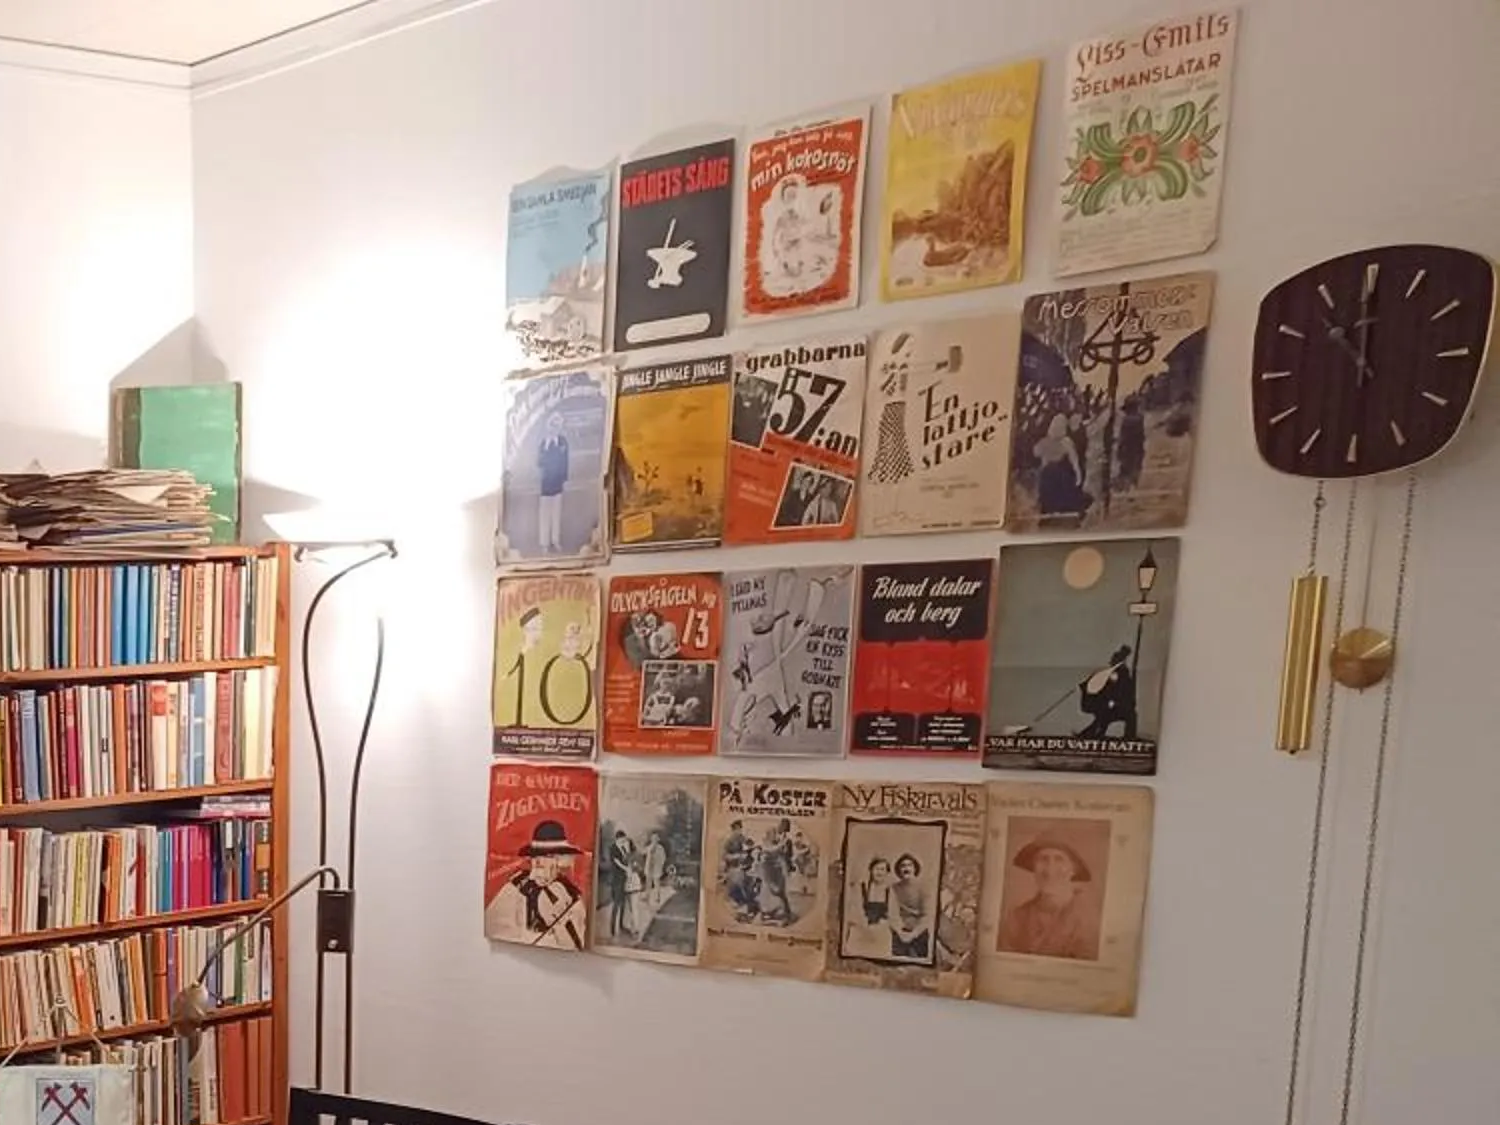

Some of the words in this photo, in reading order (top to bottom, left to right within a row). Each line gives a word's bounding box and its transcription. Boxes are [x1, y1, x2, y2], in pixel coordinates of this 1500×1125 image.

[686, 156, 730, 191] SÅNG
[751, 161, 783, 191] min
[746, 341, 866, 373] grabbarna
[918, 380, 959, 422] En
[873, 576, 929, 600] Bland
[930, 576, 982, 597] dalar
[885, 601, 916, 623] och
[920, 601, 963, 629] berg
[1048, 739, 1065, 749] DU
[719, 781, 743, 804] PÅ
[753, 783, 828, 808] KOSTER
[843, 784, 875, 810] Ny
